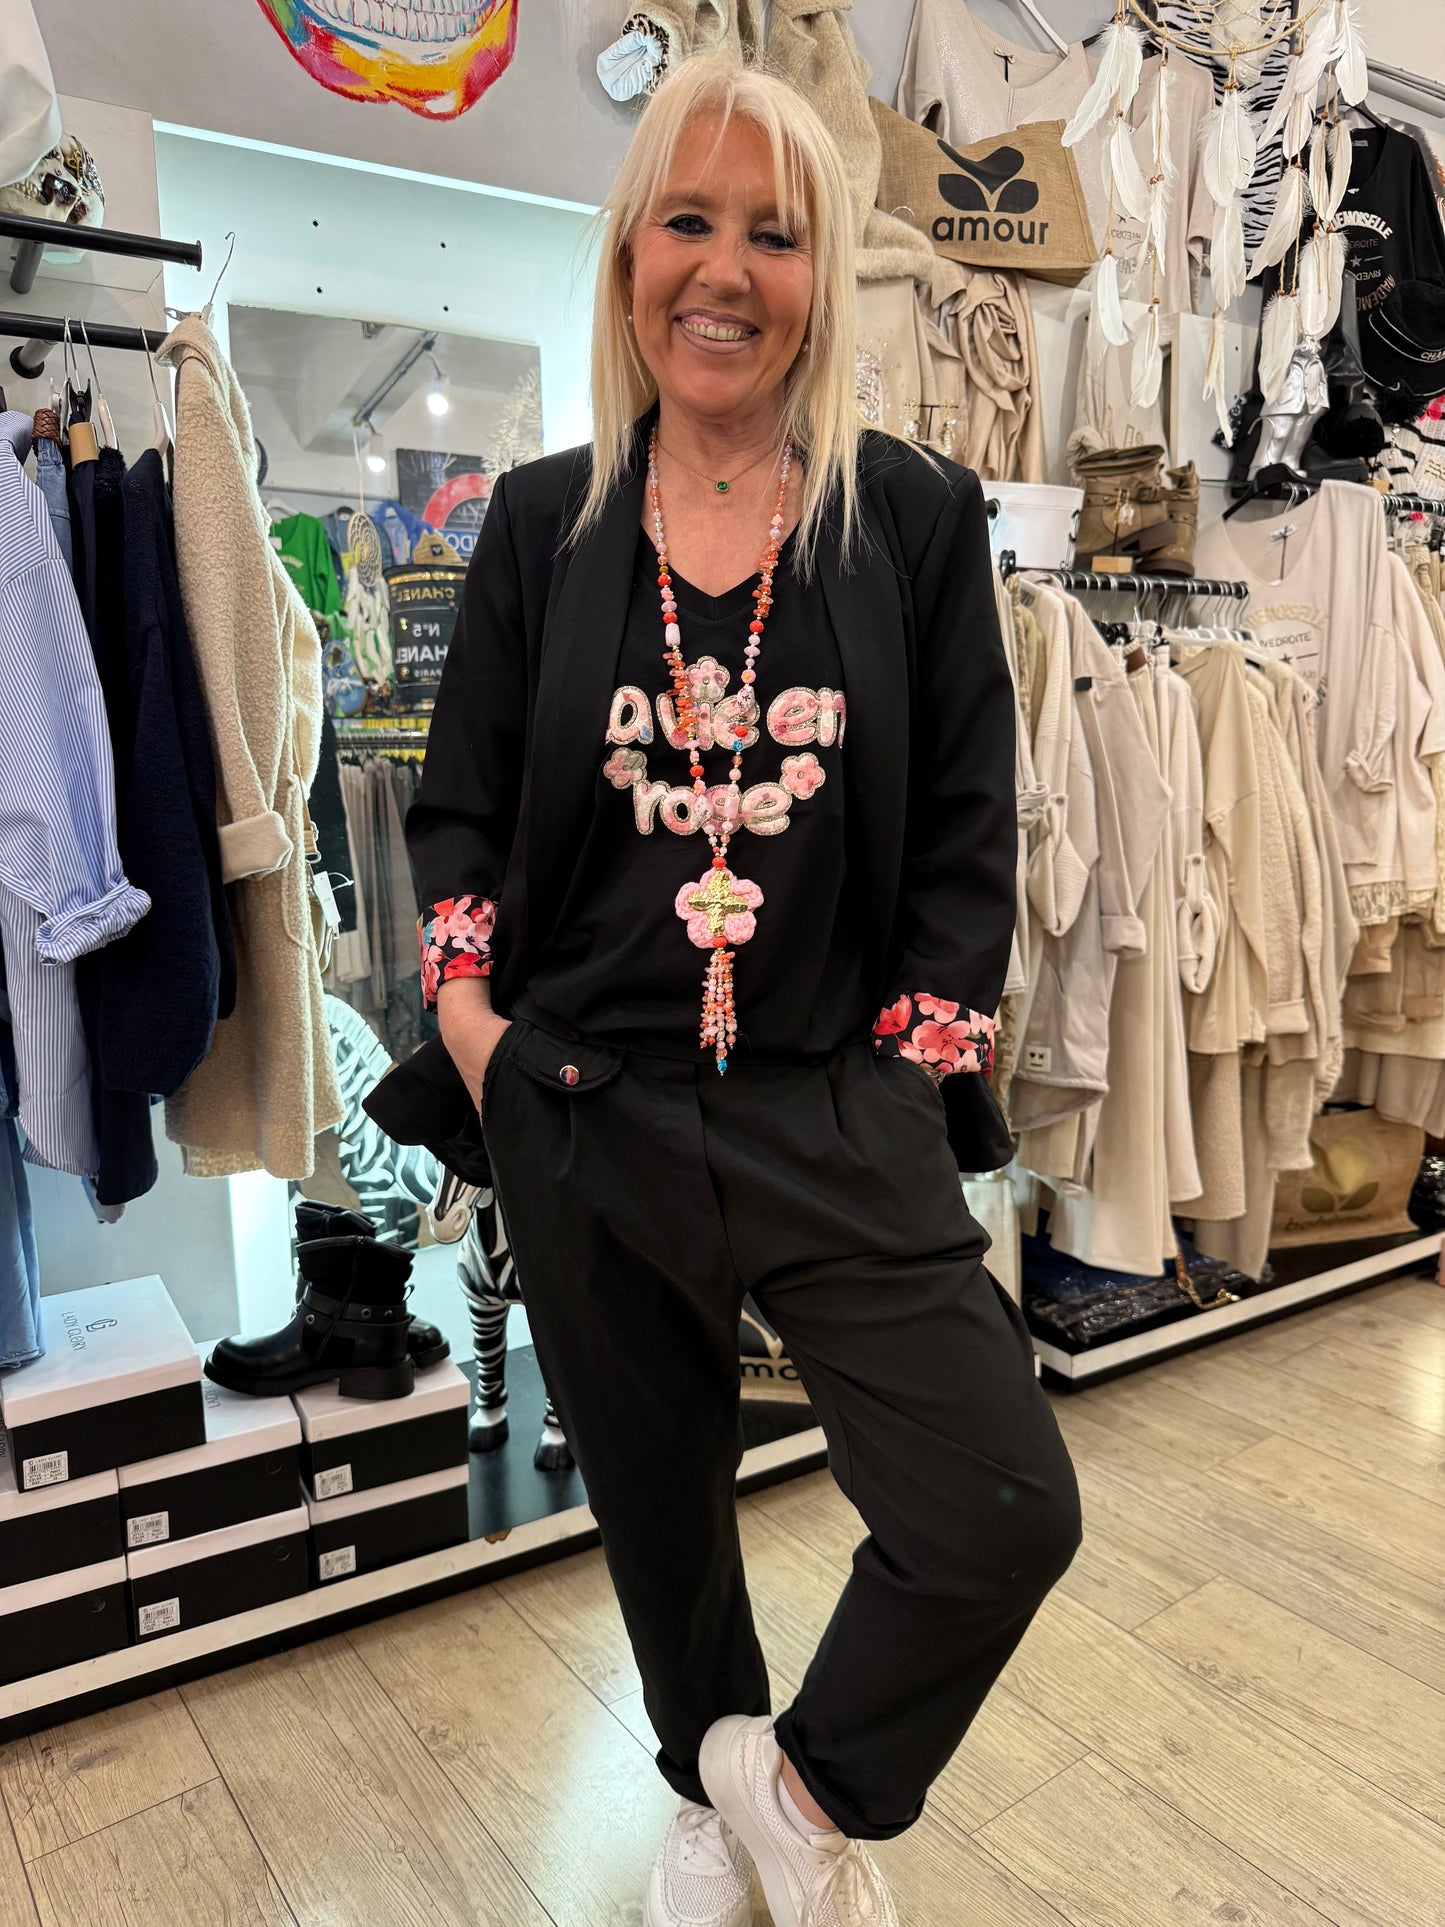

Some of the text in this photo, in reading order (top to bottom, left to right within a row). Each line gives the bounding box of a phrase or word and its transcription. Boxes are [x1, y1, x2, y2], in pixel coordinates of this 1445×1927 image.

[931, 215, 1049, 245] amour
[1329, 210, 1394, 240] DEMOISELLE
[1259, 631, 1312, 648] IVEDROITE
[61, 1310, 88, 1351] LADY GLORY
